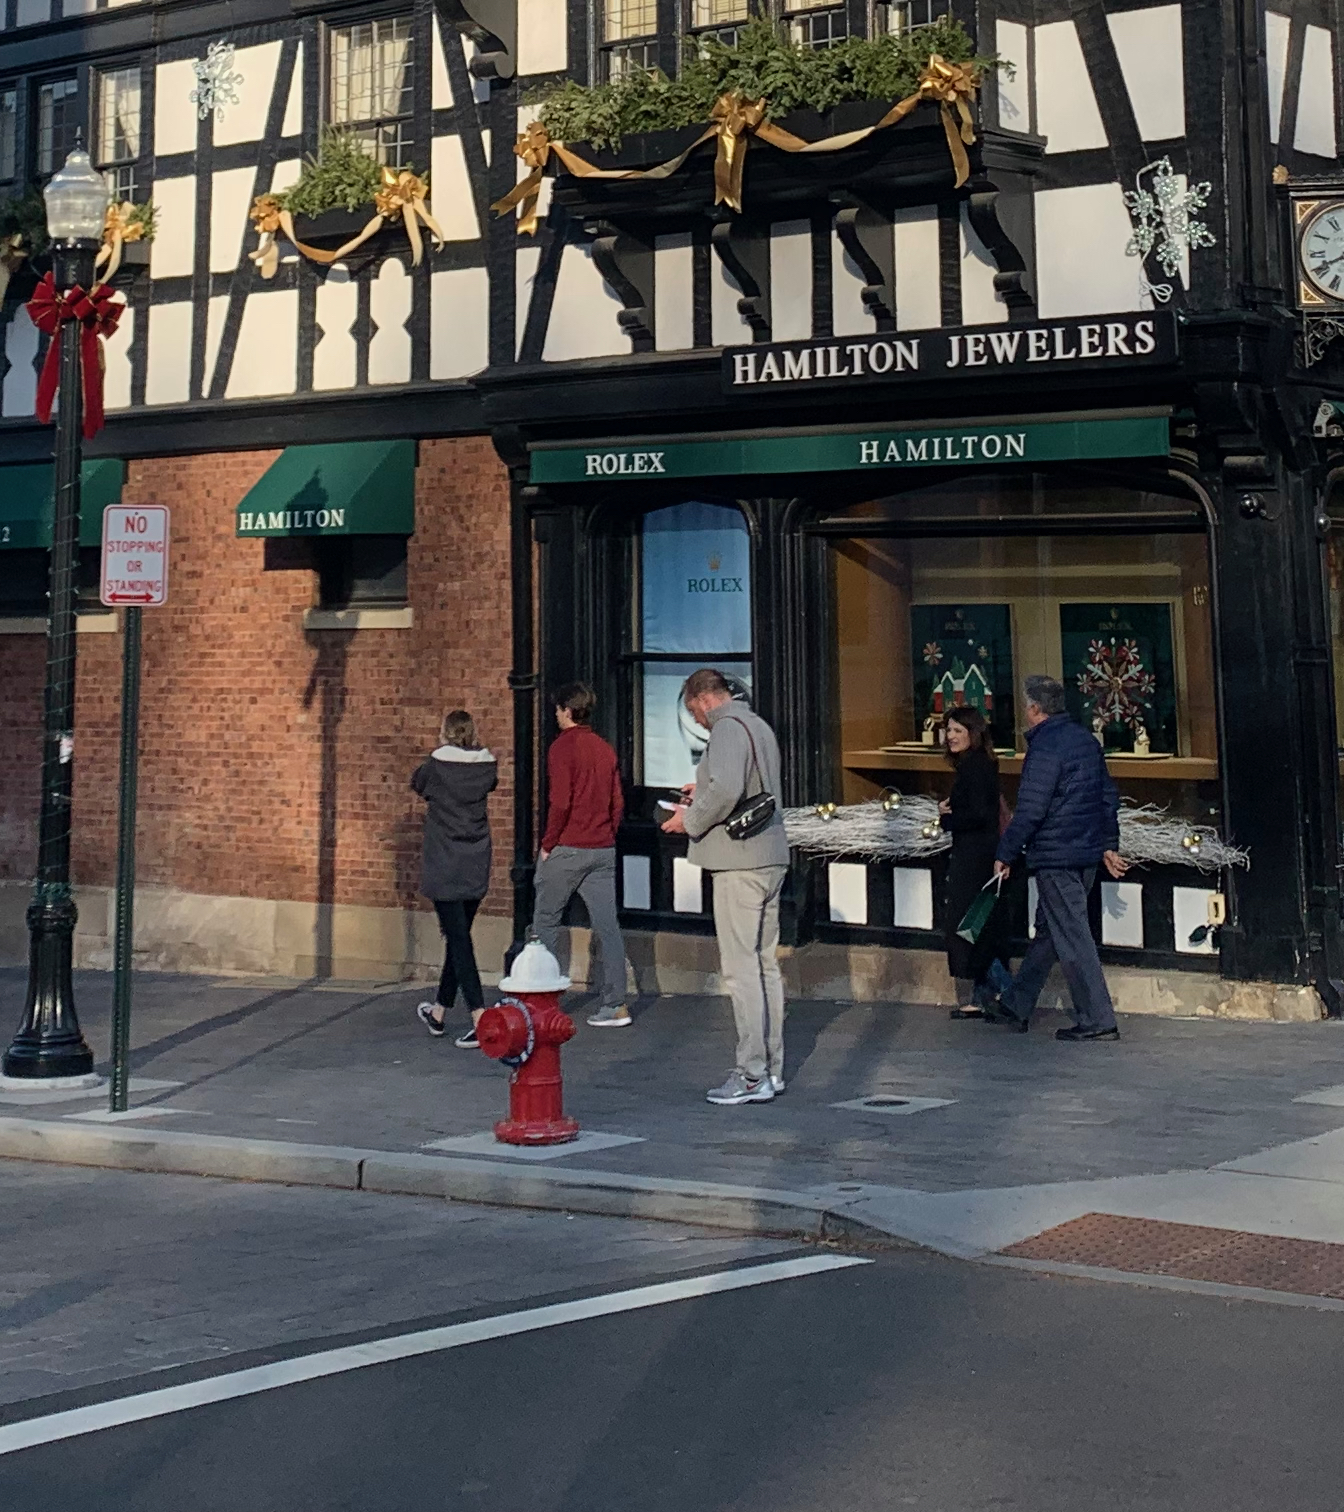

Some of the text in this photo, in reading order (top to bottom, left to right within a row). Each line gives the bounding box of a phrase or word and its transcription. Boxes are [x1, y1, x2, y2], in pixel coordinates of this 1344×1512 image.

[732, 320, 1156, 385] HAMILTON JEWELERS
[859, 433, 1027, 464] HAMILTON
[585, 452, 666, 476] ROLEX
[124, 516, 148, 534] NO
[239, 509, 345, 531] HAMILTON
[106, 540, 164, 554] STOPPING
[126, 560, 143, 573] OR
[106, 579, 162, 594] STANDING
[687, 577, 744, 593] ROLEX
